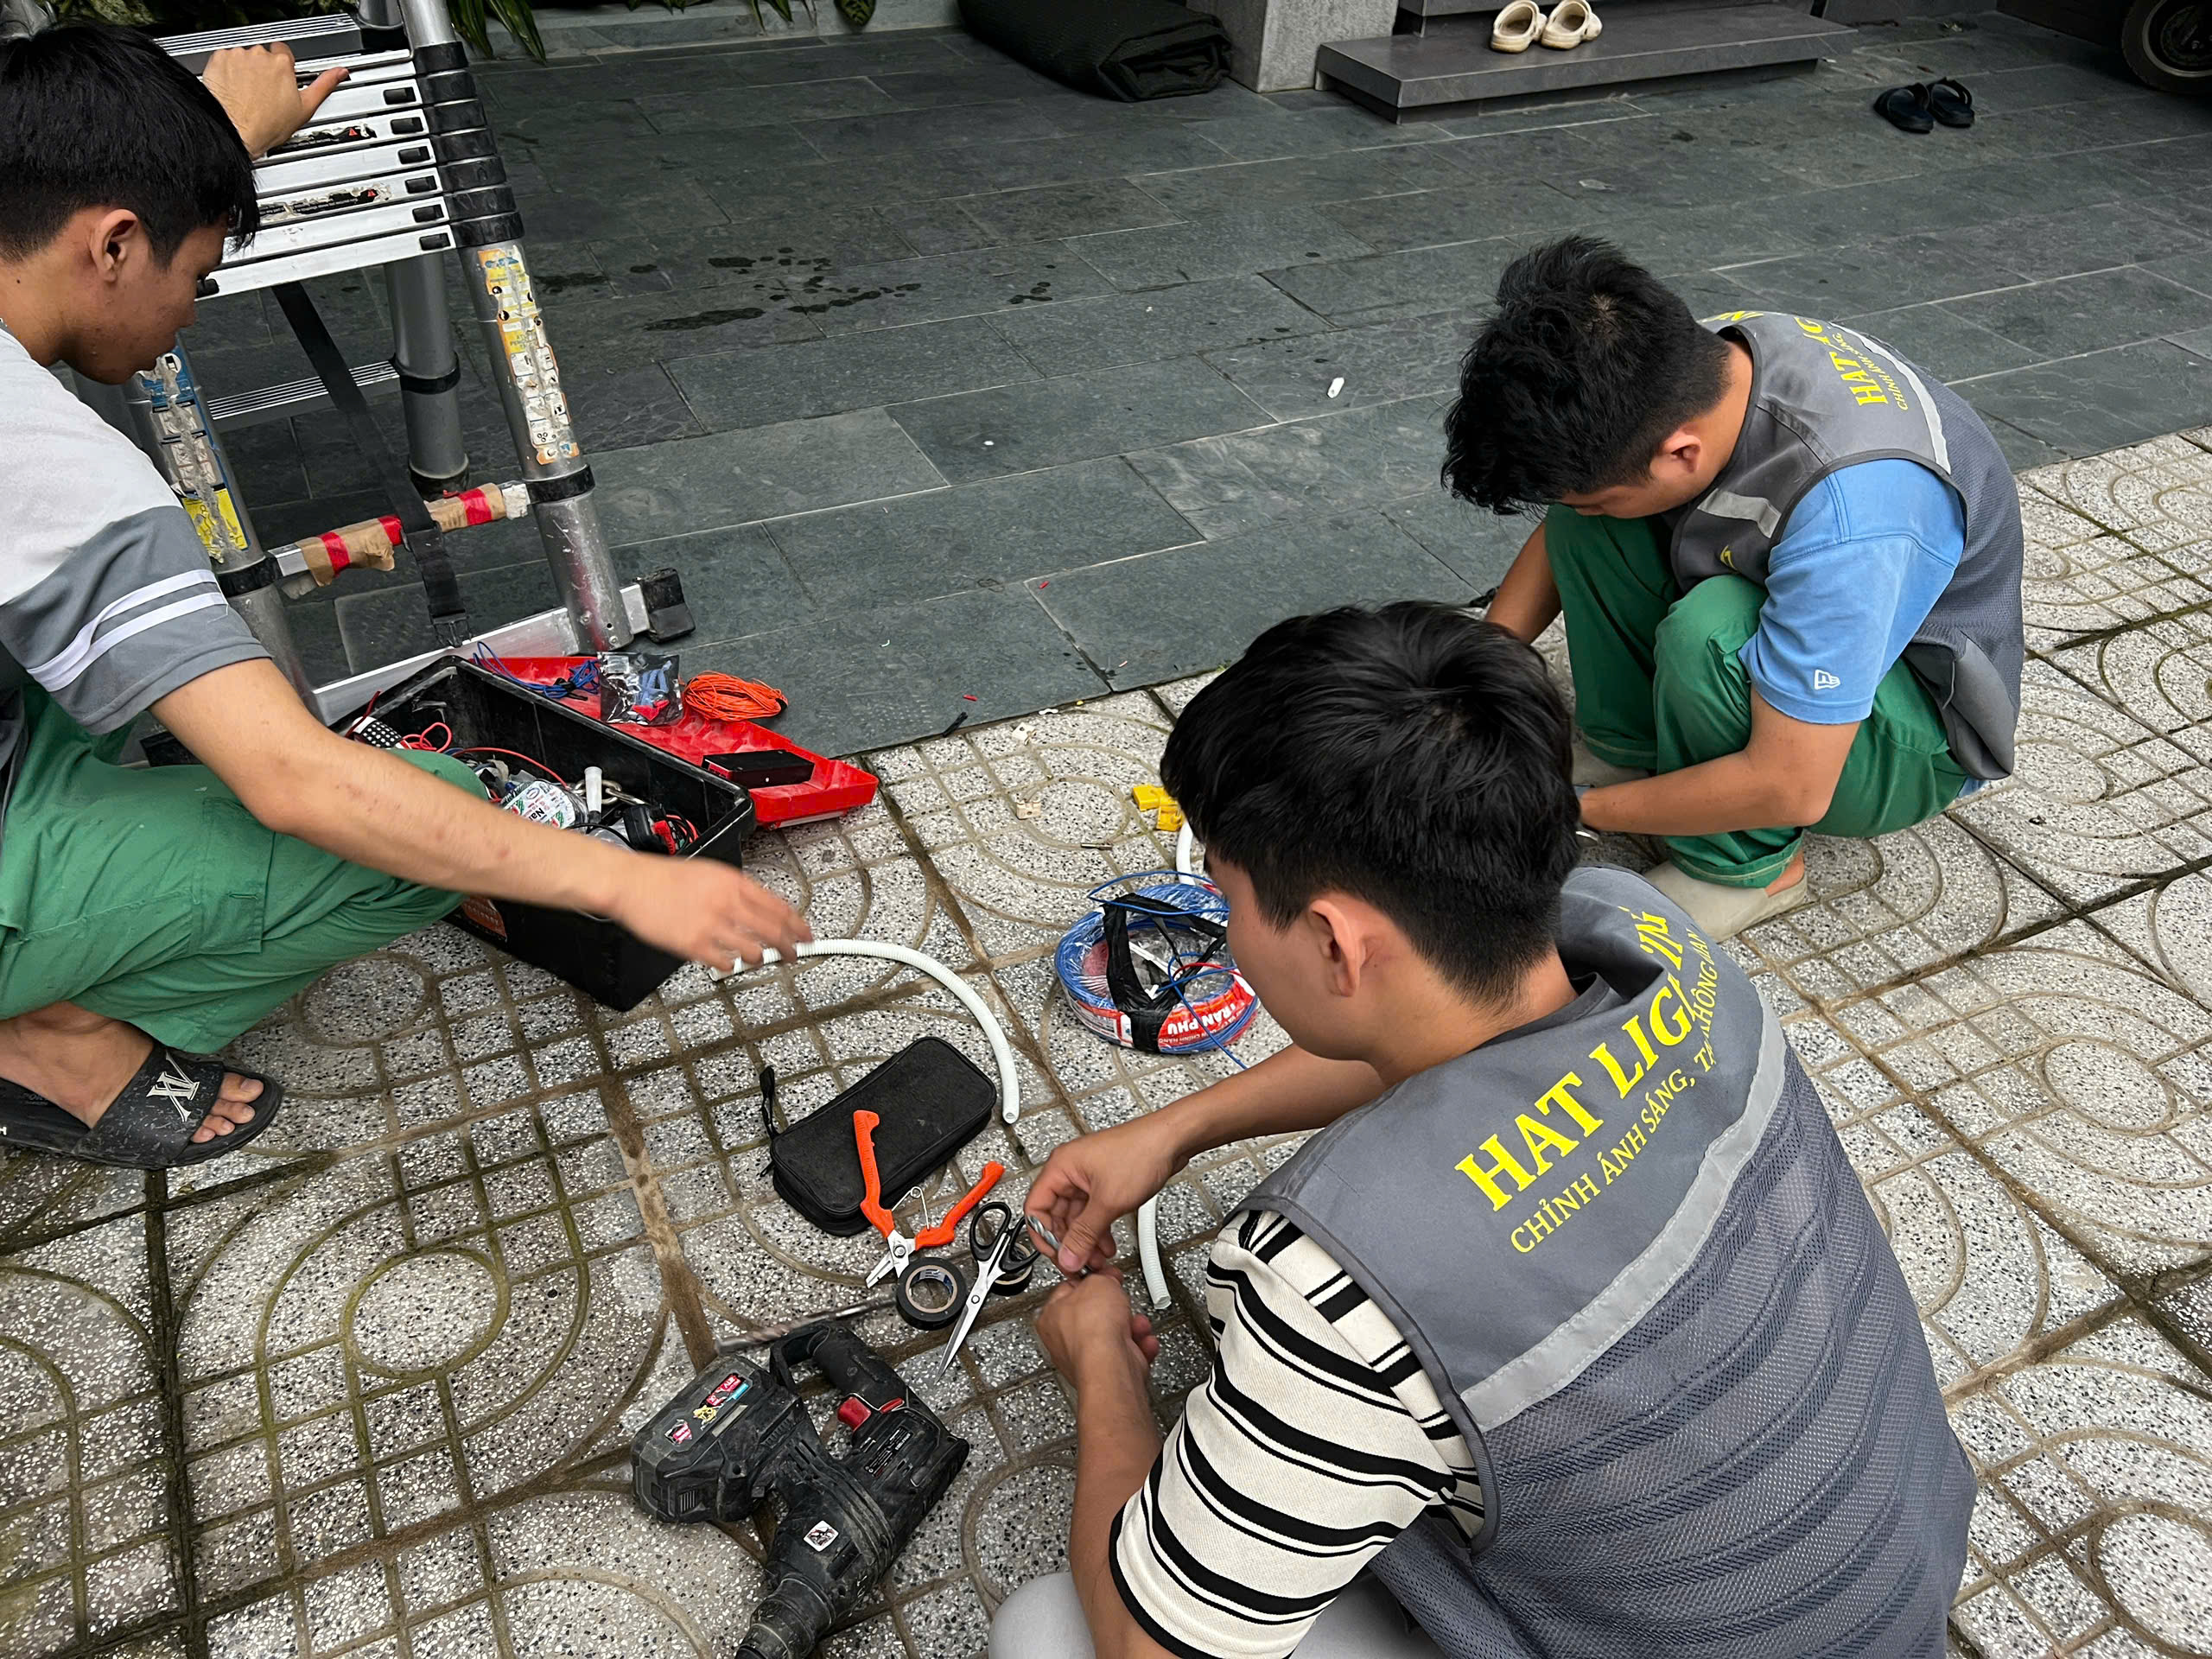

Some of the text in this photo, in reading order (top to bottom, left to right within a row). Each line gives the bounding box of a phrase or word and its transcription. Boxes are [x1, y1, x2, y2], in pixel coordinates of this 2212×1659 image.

[1829, 351, 1889, 406] HAT
[1454, 1071, 1605, 1212] HAT
[1510, 1173, 1601, 1253] CHỈNH
[1597, 1123, 1647, 1185] ÁNH
[1641, 1068, 1696, 1134] SÁNG,
